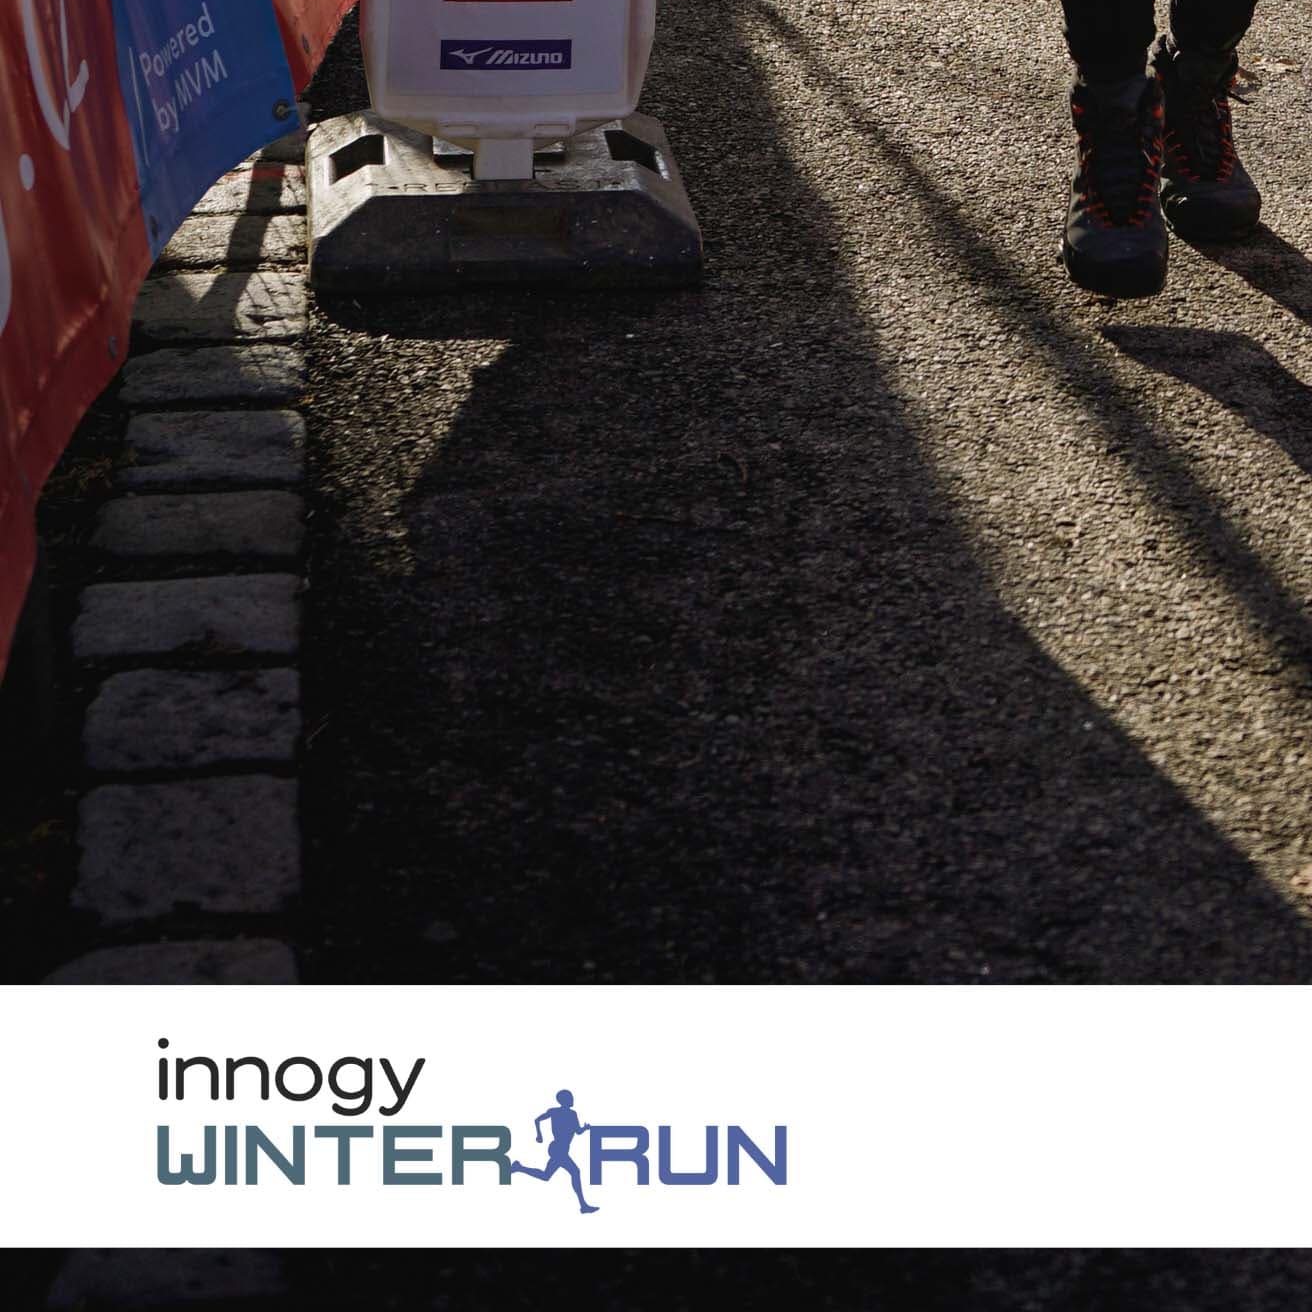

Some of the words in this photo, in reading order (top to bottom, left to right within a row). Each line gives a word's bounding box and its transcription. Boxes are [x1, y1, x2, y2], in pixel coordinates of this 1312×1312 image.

[138, 1, 215, 87] Powered
[152, 96, 180, 133] by
[174, 49, 229, 112] MVM
